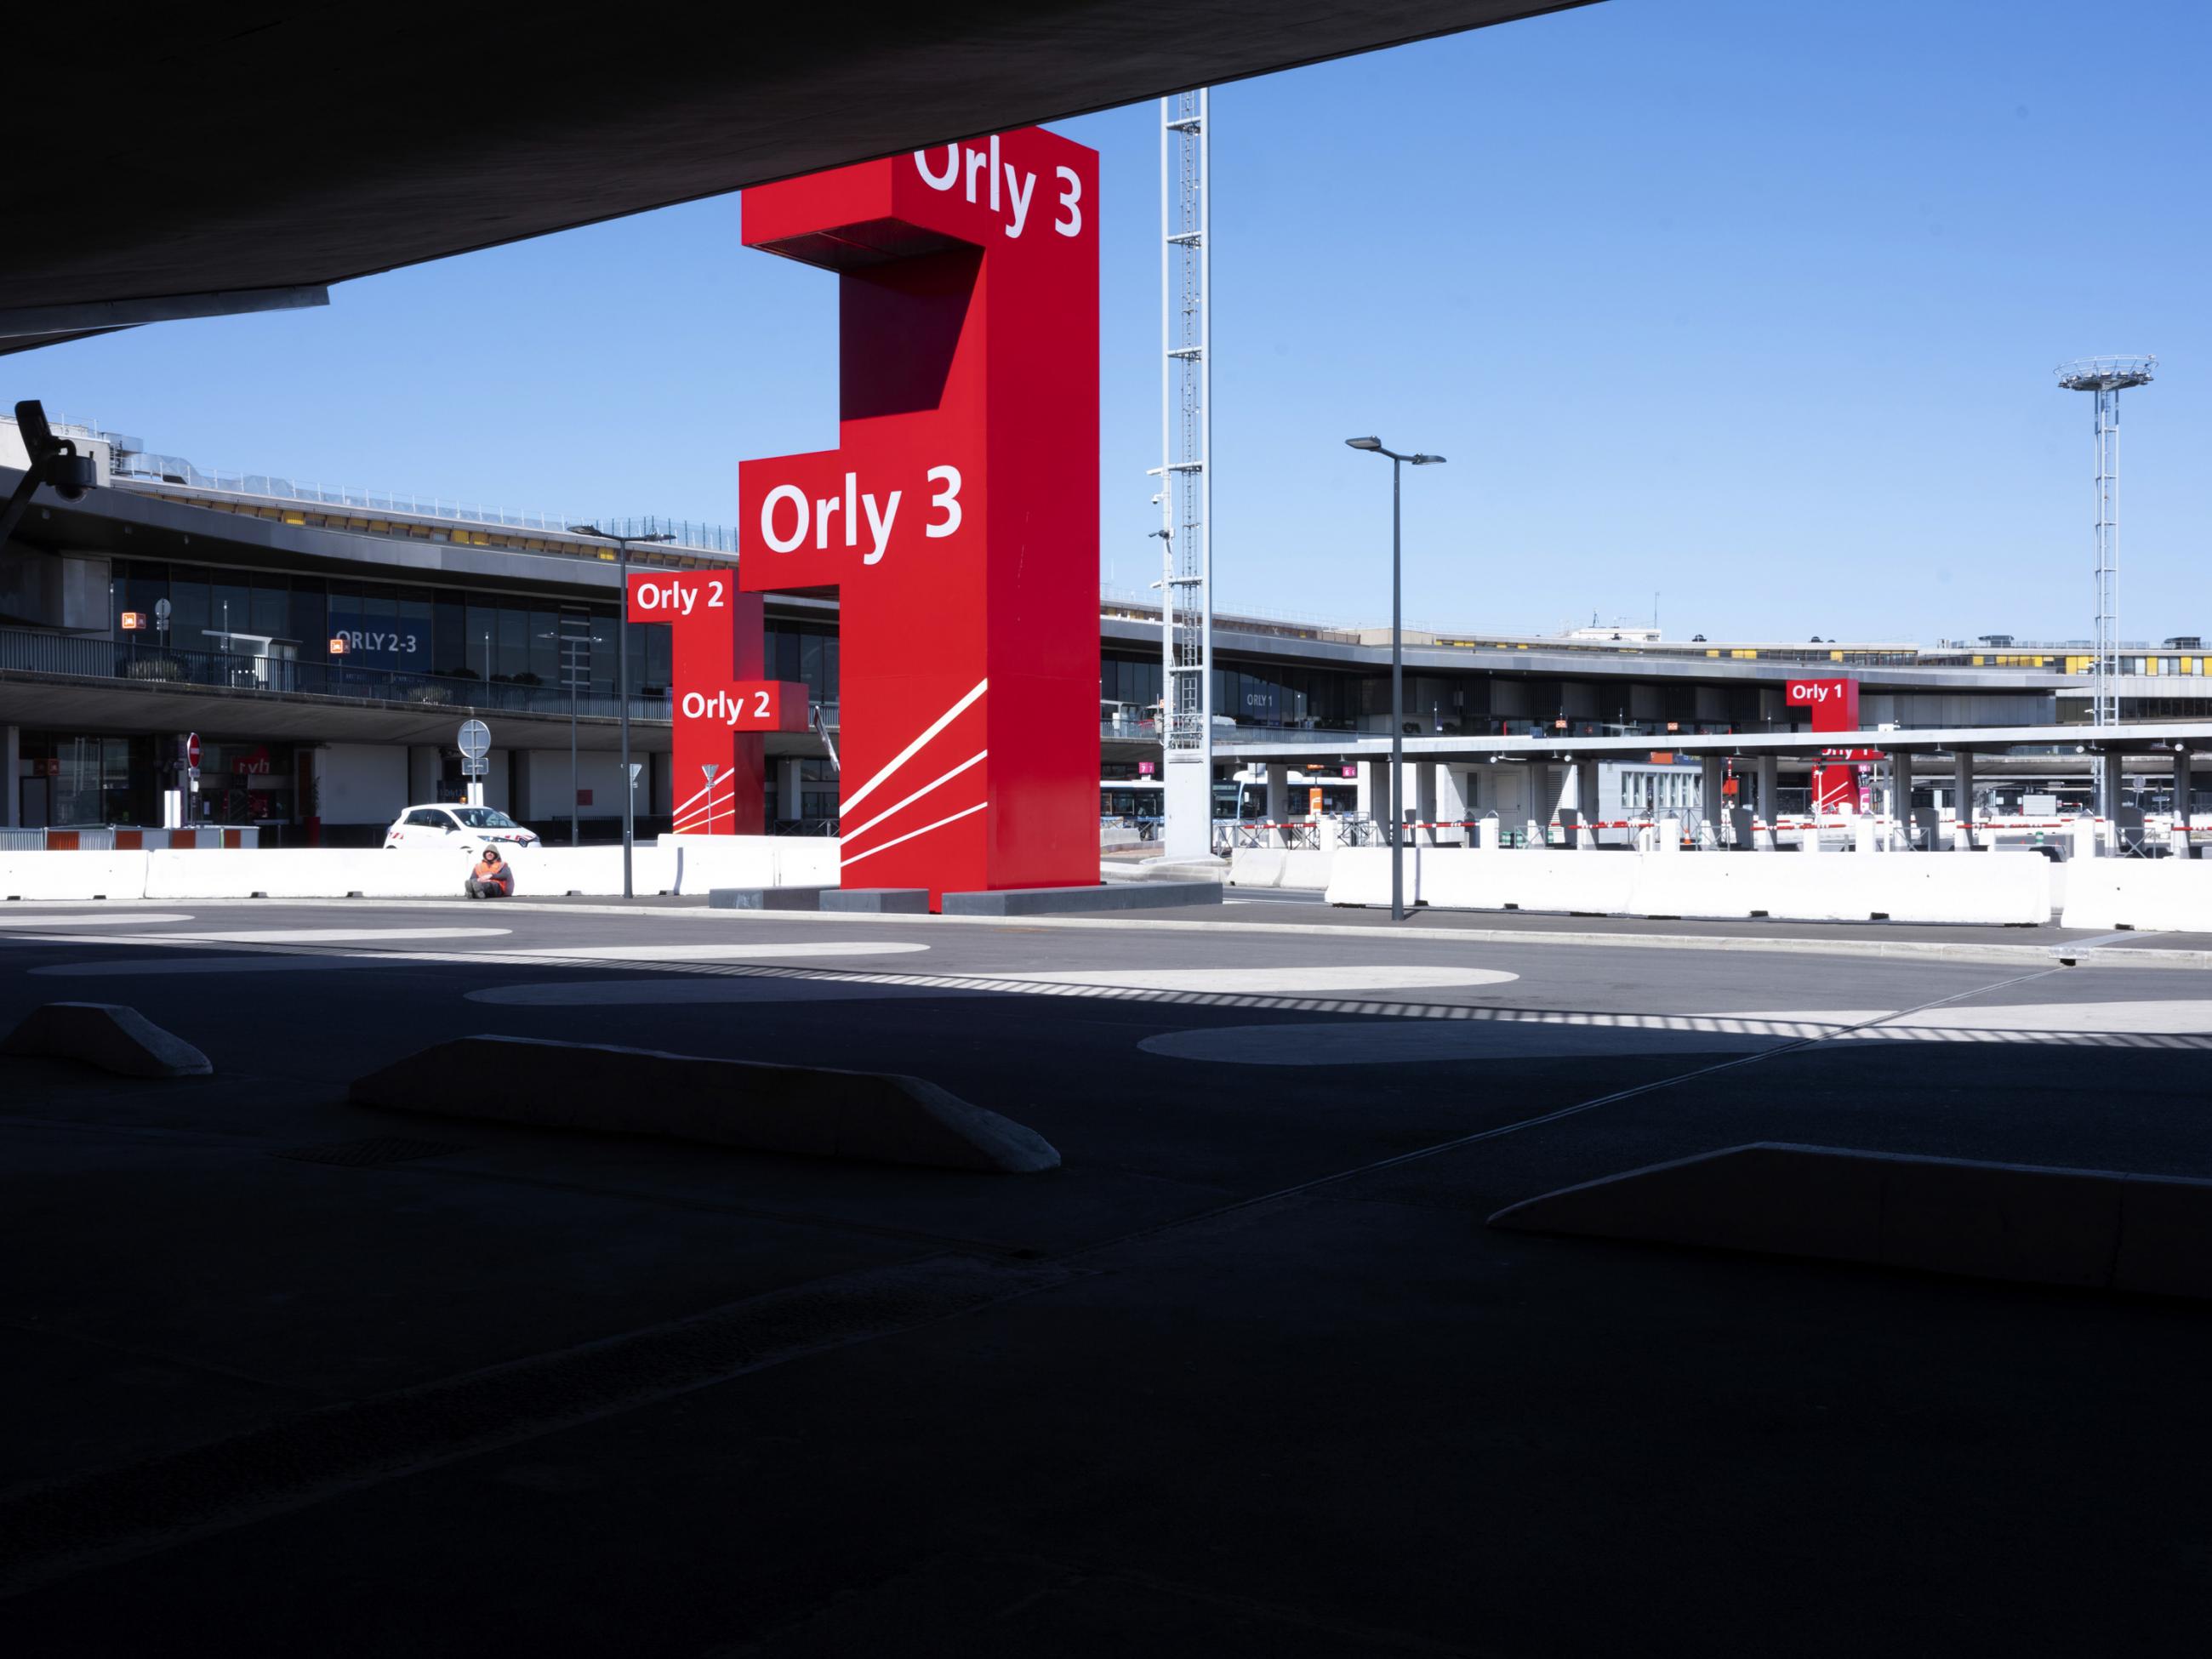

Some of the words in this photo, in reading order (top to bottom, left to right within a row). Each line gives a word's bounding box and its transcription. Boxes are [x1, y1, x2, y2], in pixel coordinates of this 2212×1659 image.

[914, 134, 1037, 239] Orly
[1055, 165, 1082, 237] 3
[761, 472, 903, 565] Orly
[926, 465, 962, 538] 3
[637, 581, 698, 615] Orly
[707, 581, 724, 607] 2
[388, 634, 417, 653] 2-3
[682, 691, 744, 725] Orly
[754, 691, 770, 718] 2
[1246, 693, 1267, 707] ORLY
[1268, 695, 1273, 707] 1
[1793, 684, 1829, 702] Orly
[1833, 684, 1842, 698] 1
